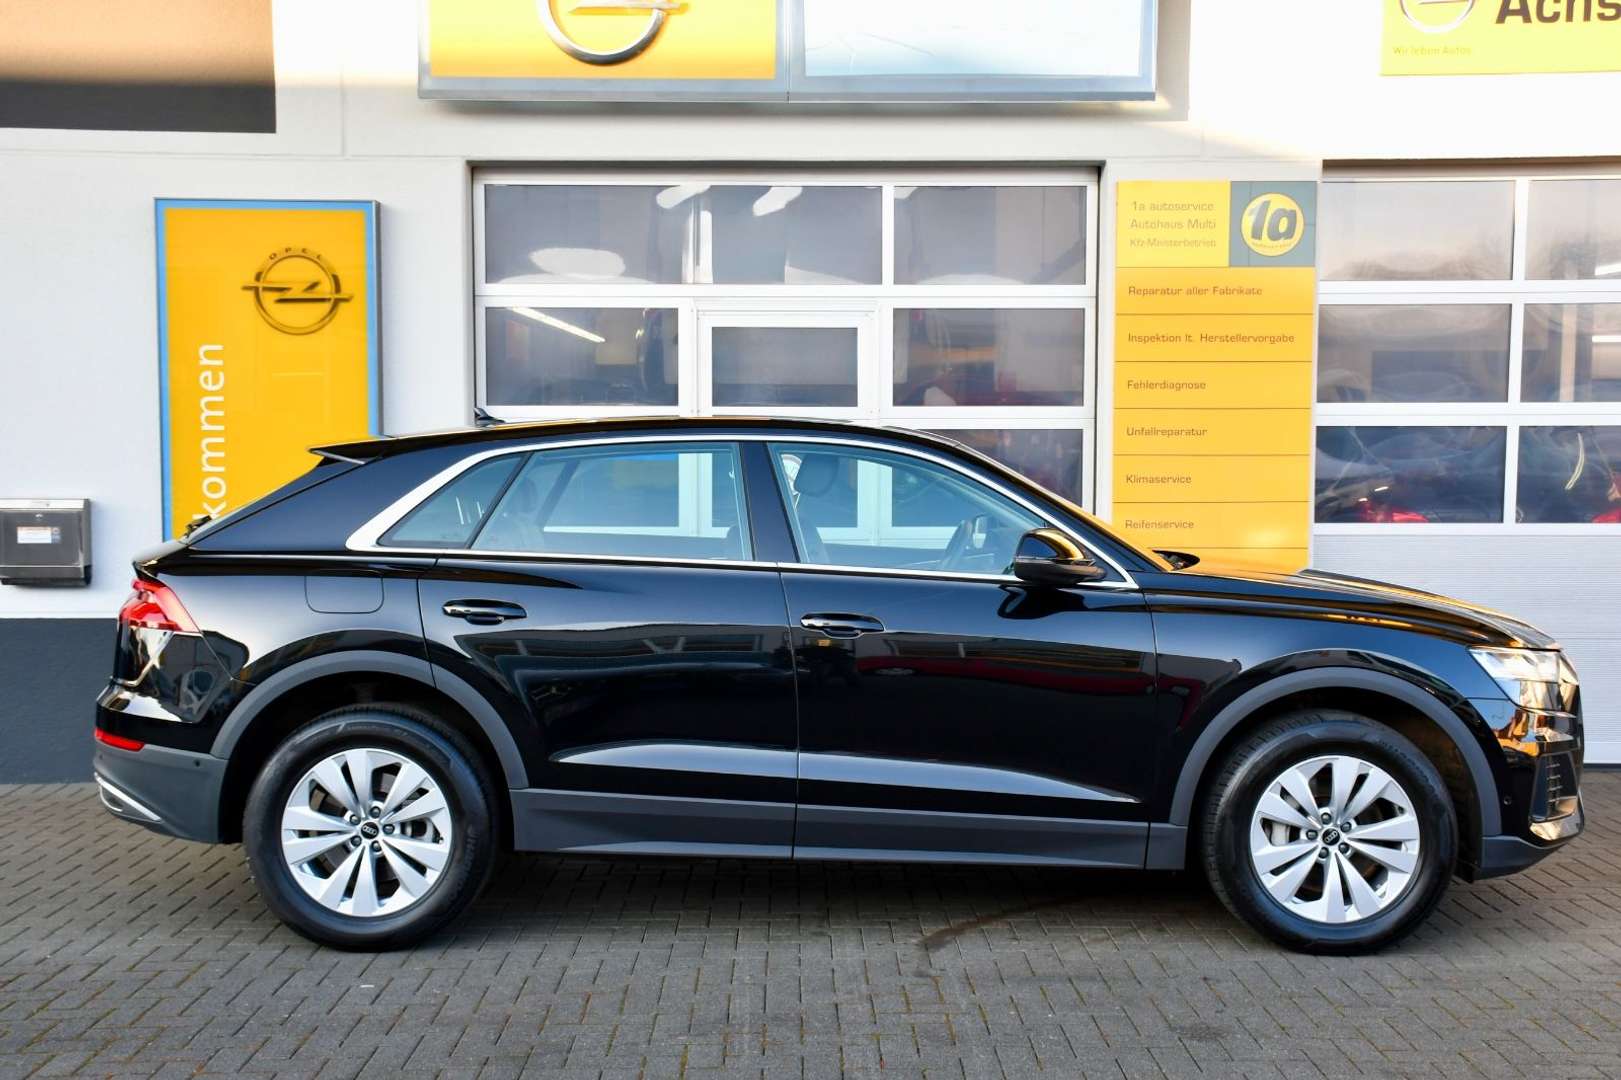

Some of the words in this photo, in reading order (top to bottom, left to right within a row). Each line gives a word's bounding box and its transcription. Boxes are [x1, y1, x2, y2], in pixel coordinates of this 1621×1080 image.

[1132, 200, 1146, 211] 1a
[1149, 201, 1214, 211] autoservice
[1130, 218, 1184, 229] Autohaus
[1187, 218, 1216, 229] Multi
[1247, 199, 1298, 241] 1a
[1128, 286, 1183, 297] Reparatur
[1186, 285, 1209, 296] aller
[1212, 285, 1263, 296] Fabrikate
[1128, 333, 1182, 345] Inspektion
[1200, 333, 1295, 345] Herstellervorgabe
[1127, 379, 1207, 391] Fehlerdiagnose
[1126, 427, 1208, 438] Unfallreparatur
[1126, 474, 1192, 484] Klimaservice
[1125, 520, 1195, 529] Reifenservice
